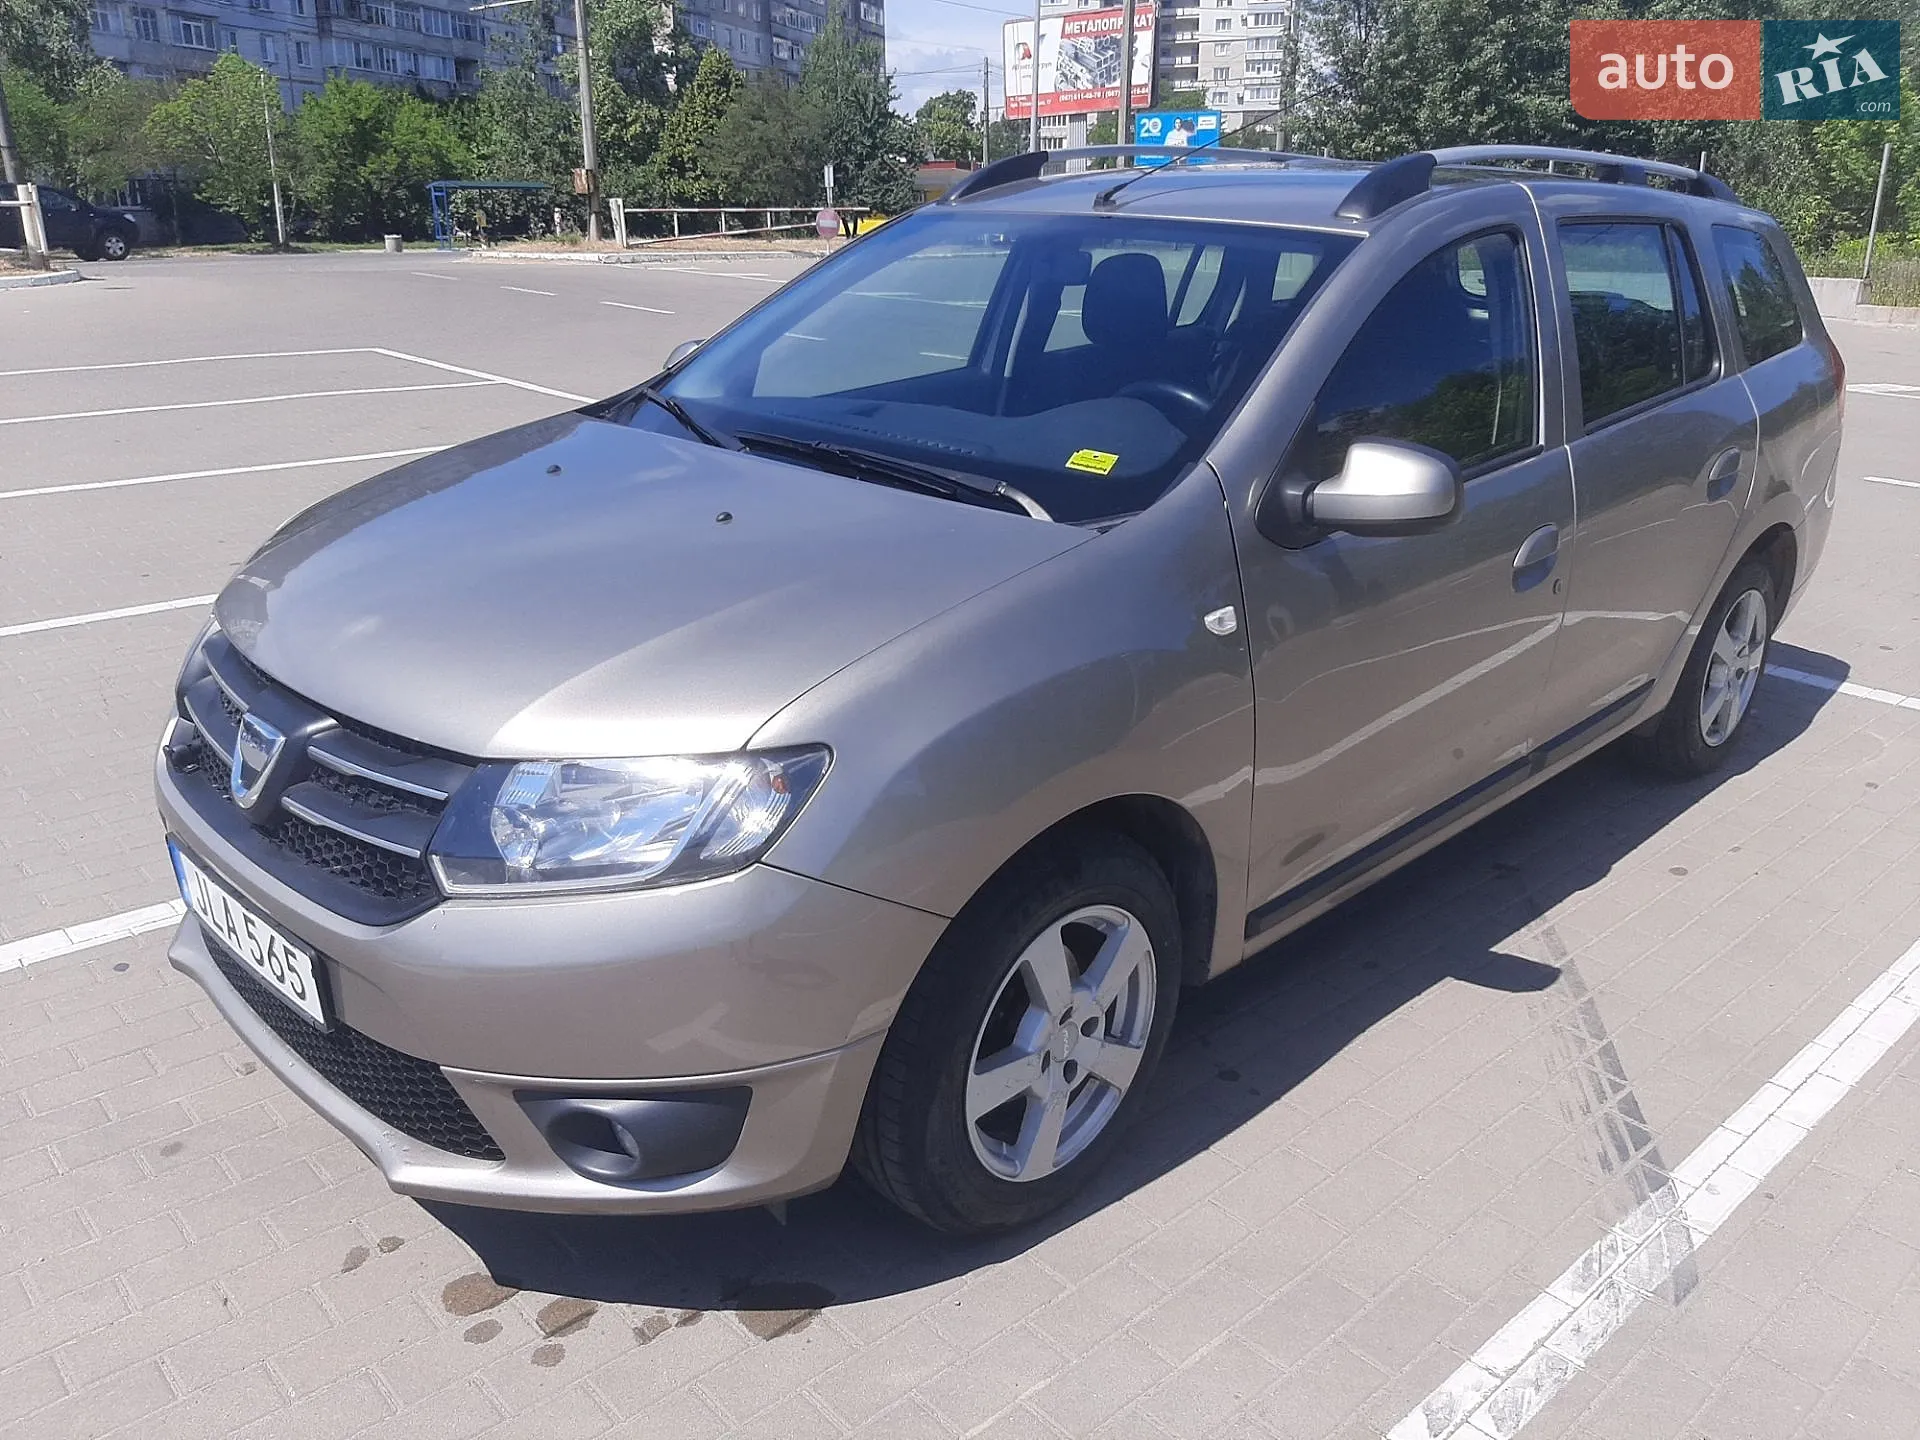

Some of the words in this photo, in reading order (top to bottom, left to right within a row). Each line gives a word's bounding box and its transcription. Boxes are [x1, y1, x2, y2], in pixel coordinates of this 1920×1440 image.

[1066, 14, 1153, 35] МЕТАЛОПРКАТ
[194, 871, 242, 950] JLA
[242, 912, 306, 1001] 565
